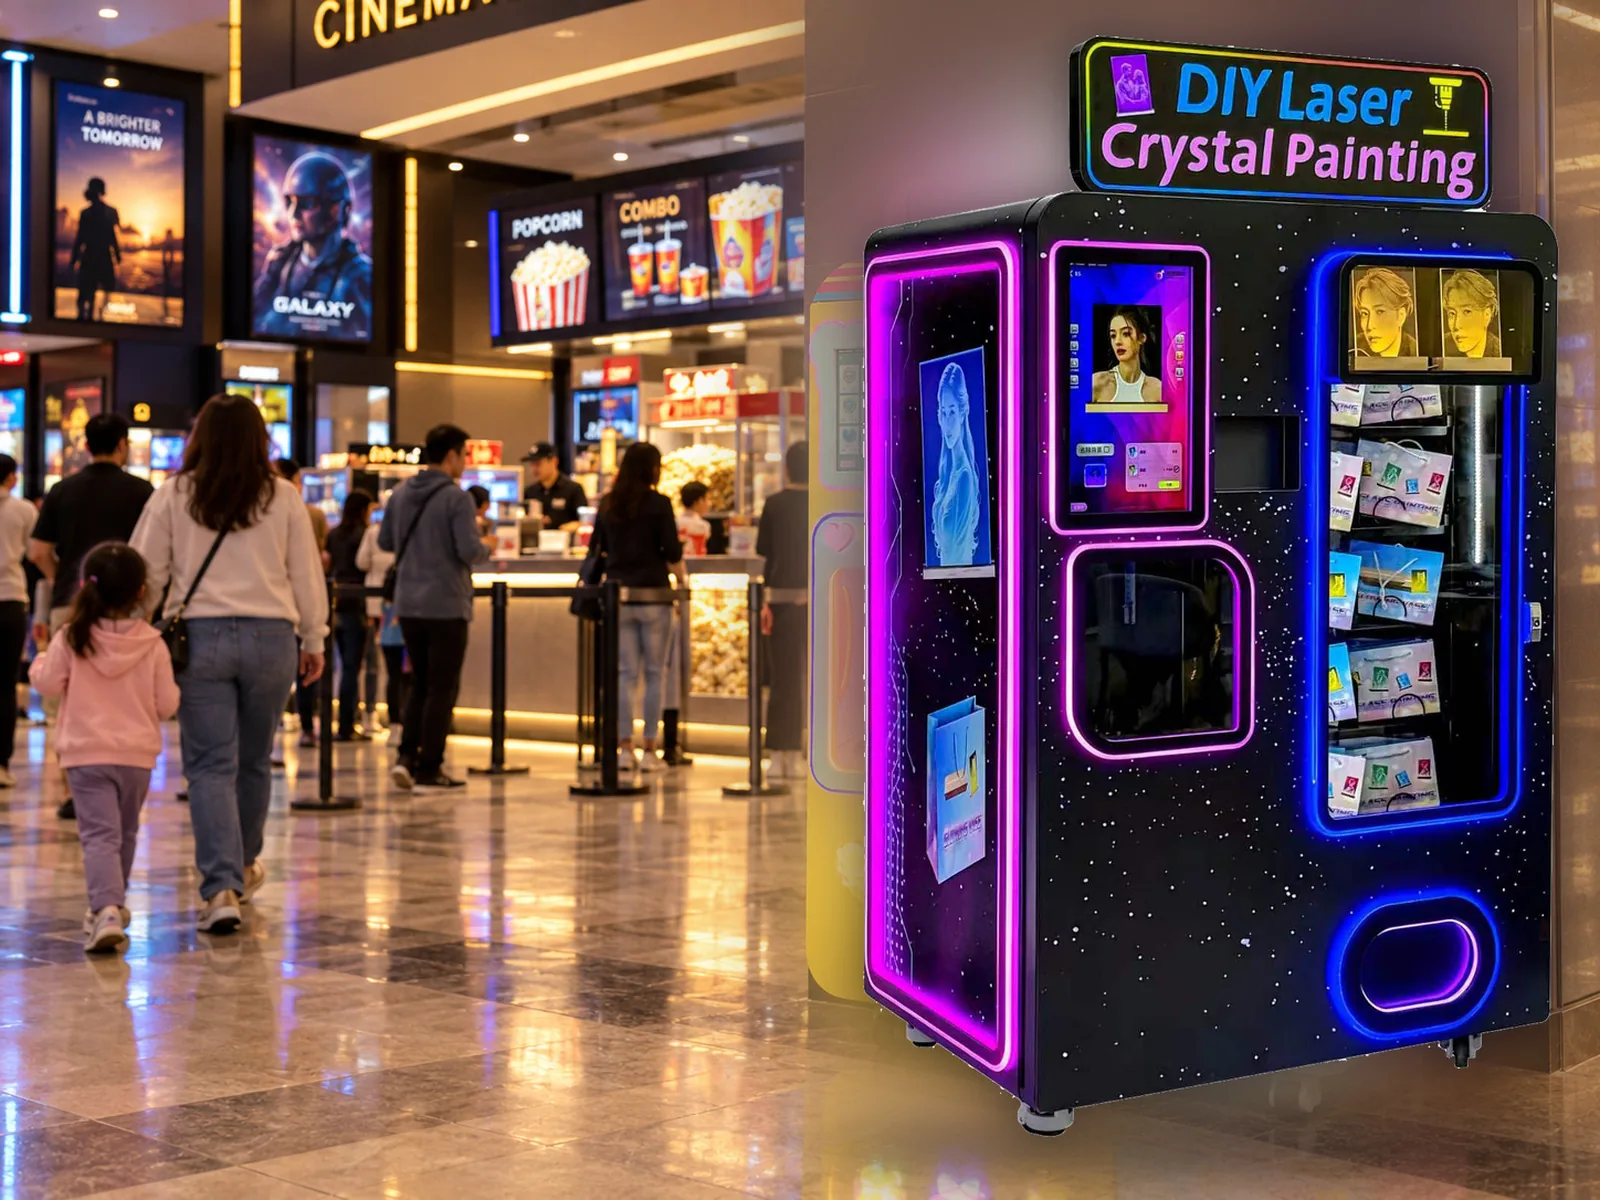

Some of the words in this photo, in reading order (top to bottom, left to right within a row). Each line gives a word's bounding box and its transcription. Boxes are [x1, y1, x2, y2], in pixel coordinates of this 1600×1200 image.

[313, 0, 491, 49] CINE
[1177, 62, 1272, 118] DIY
[1278, 70, 1413, 126] Laser
[83, 109, 95, 125] A
[97, 111, 162, 134] BRIGHTER
[81, 126, 163, 151] TOMORROW
[1102, 122, 1275, 187] Crystal
[1285, 132, 1477, 200] Painting
[512, 209, 583, 239] POPCORN
[619, 194, 680, 224] COMBO
[273, 295, 355, 319] GALAXY
